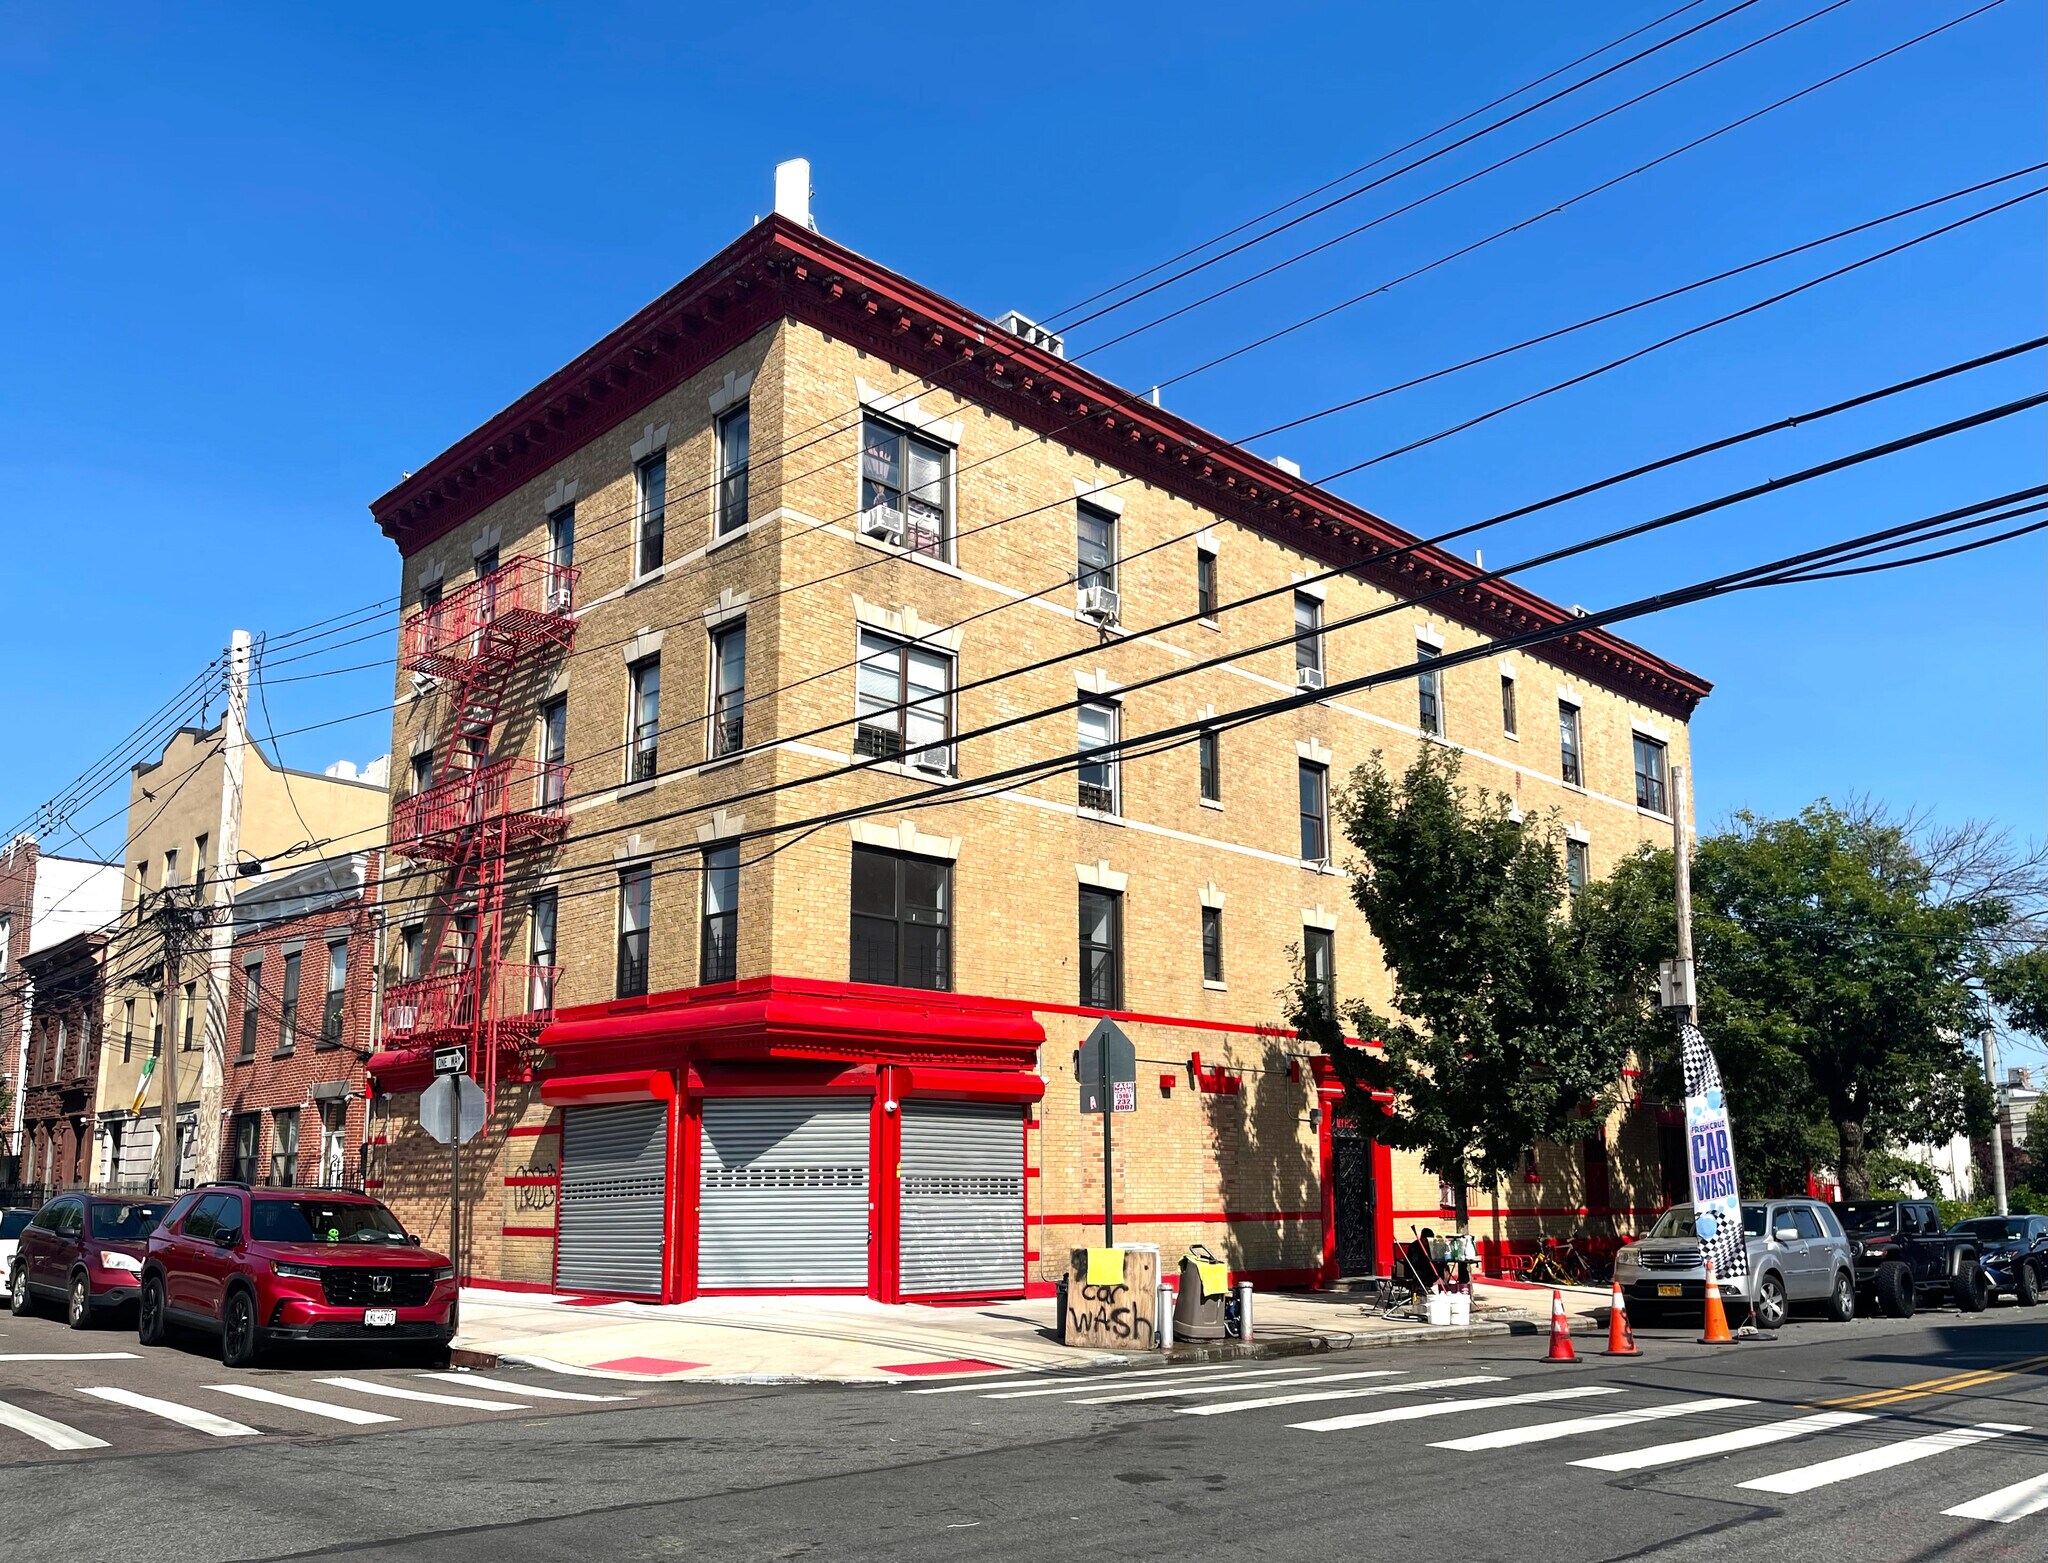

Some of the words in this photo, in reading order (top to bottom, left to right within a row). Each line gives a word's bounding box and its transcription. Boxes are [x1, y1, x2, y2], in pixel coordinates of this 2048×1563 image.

[438, 1057, 447, 1068] ONE
[450, 1054, 460, 1066] WAY
[1709, 1120, 1725, 1130] CRUZ
[1692, 1130, 1730, 1174] CAR
[1695, 1169, 1735, 1201] WASH
